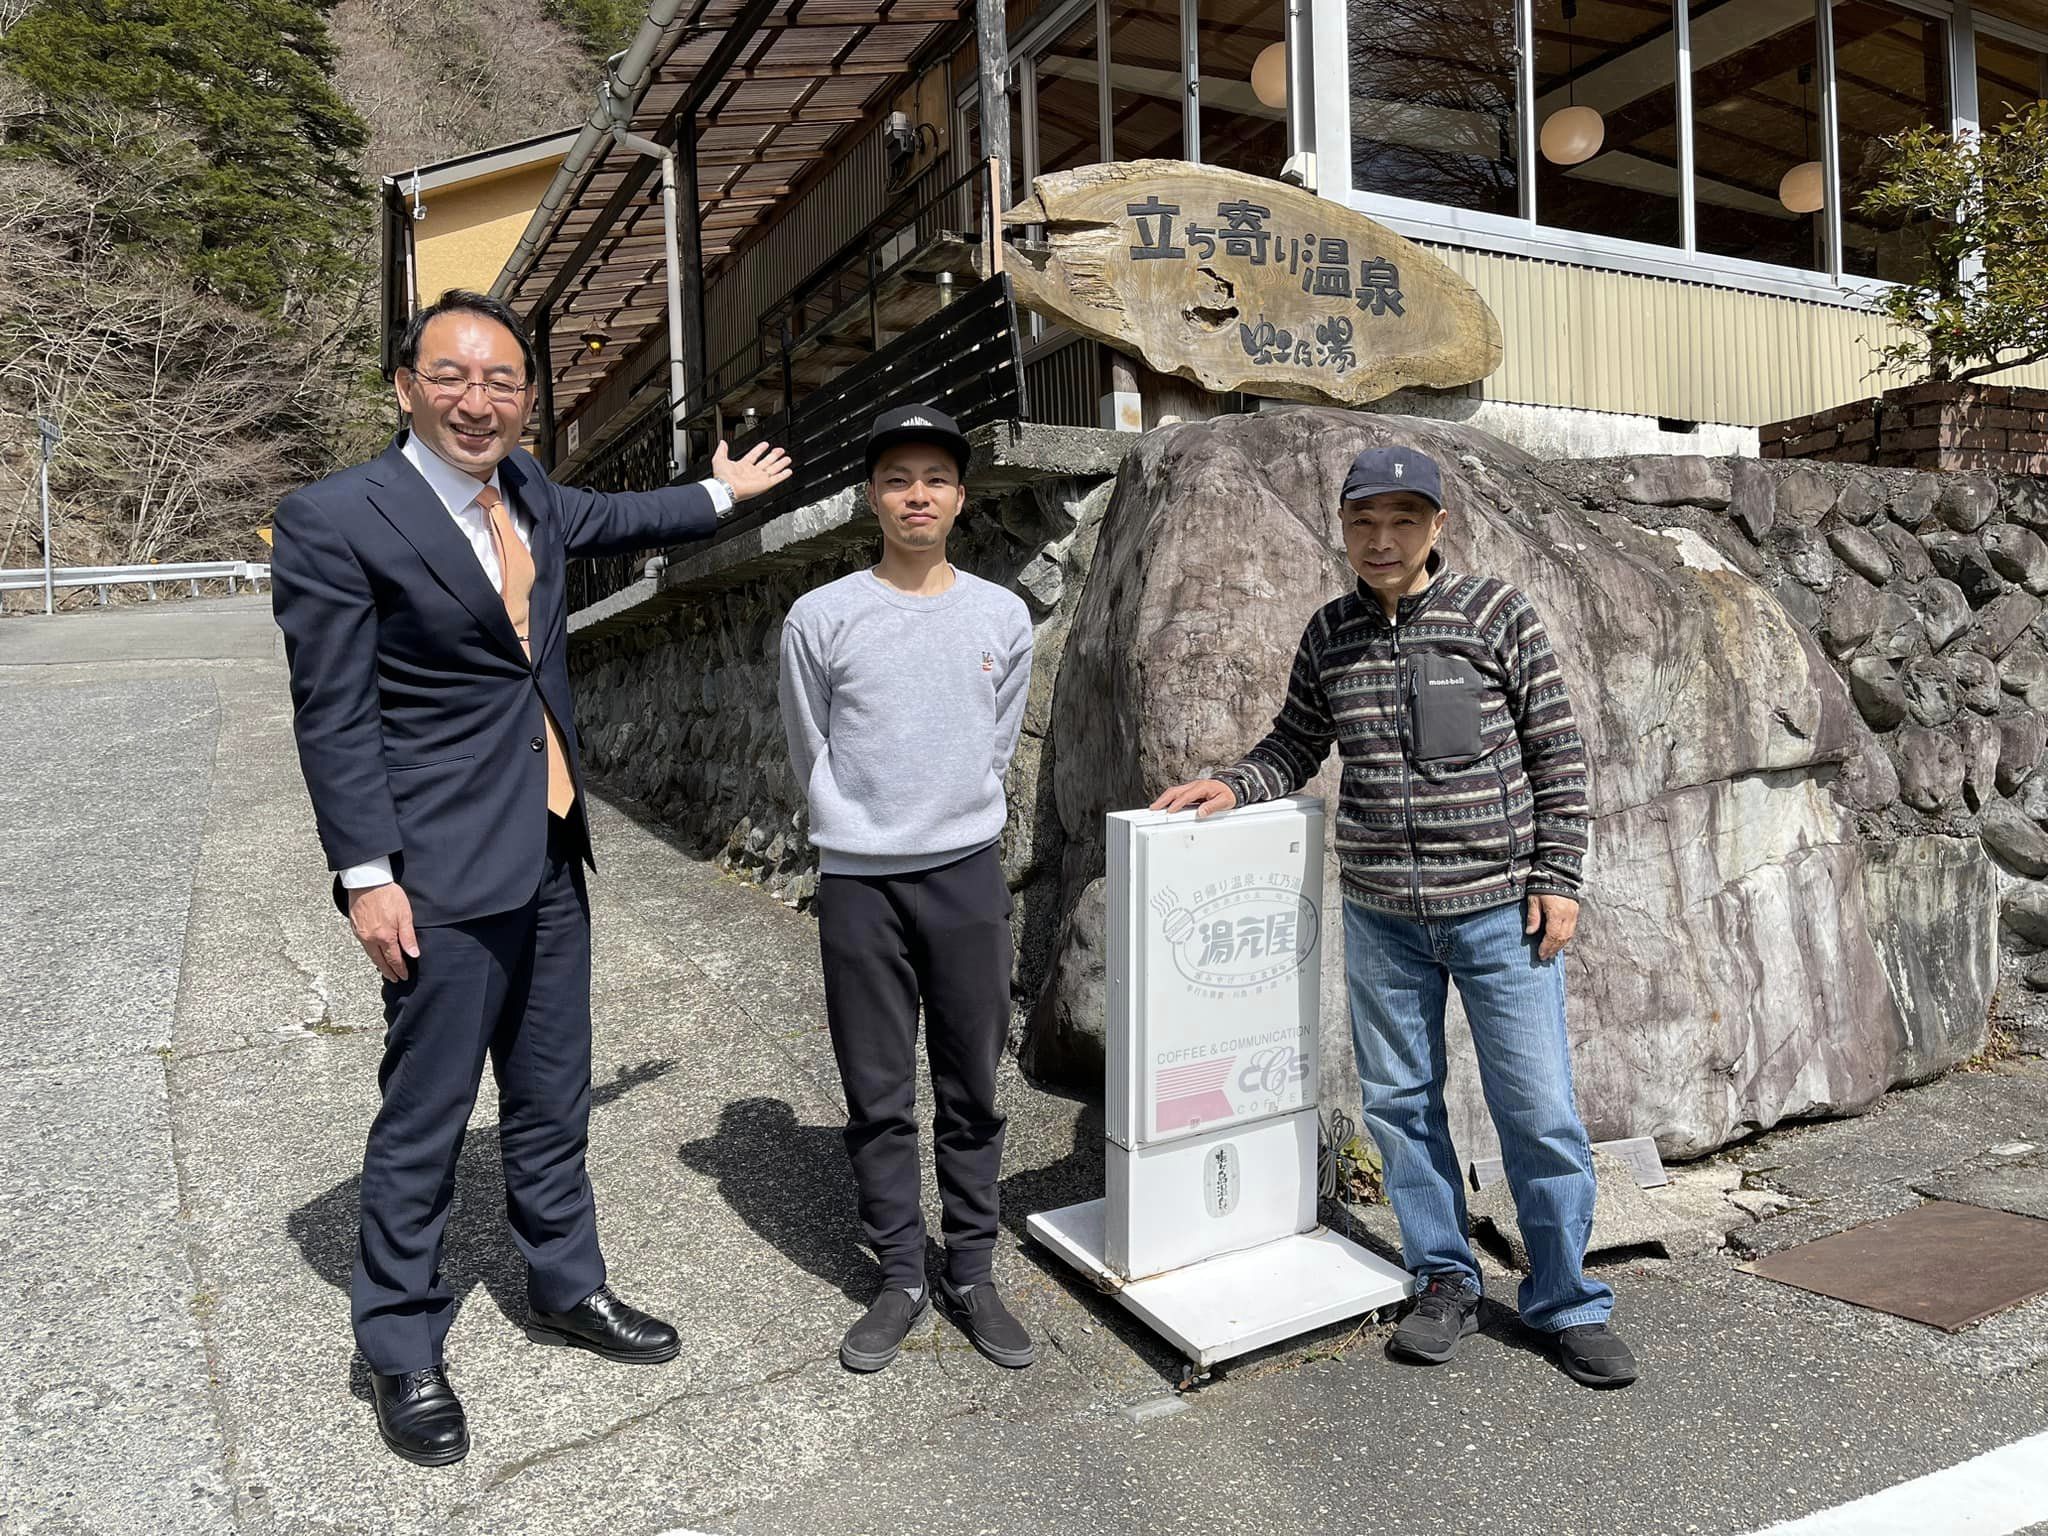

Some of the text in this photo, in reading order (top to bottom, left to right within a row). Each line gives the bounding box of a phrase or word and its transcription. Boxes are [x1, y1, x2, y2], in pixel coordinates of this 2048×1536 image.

[1126, 196, 1405, 317] 立ち寄り温泉
[1197, 910, 1297, 967] 湯元屋
[1157, 1044, 1207, 1065] COFFEE
